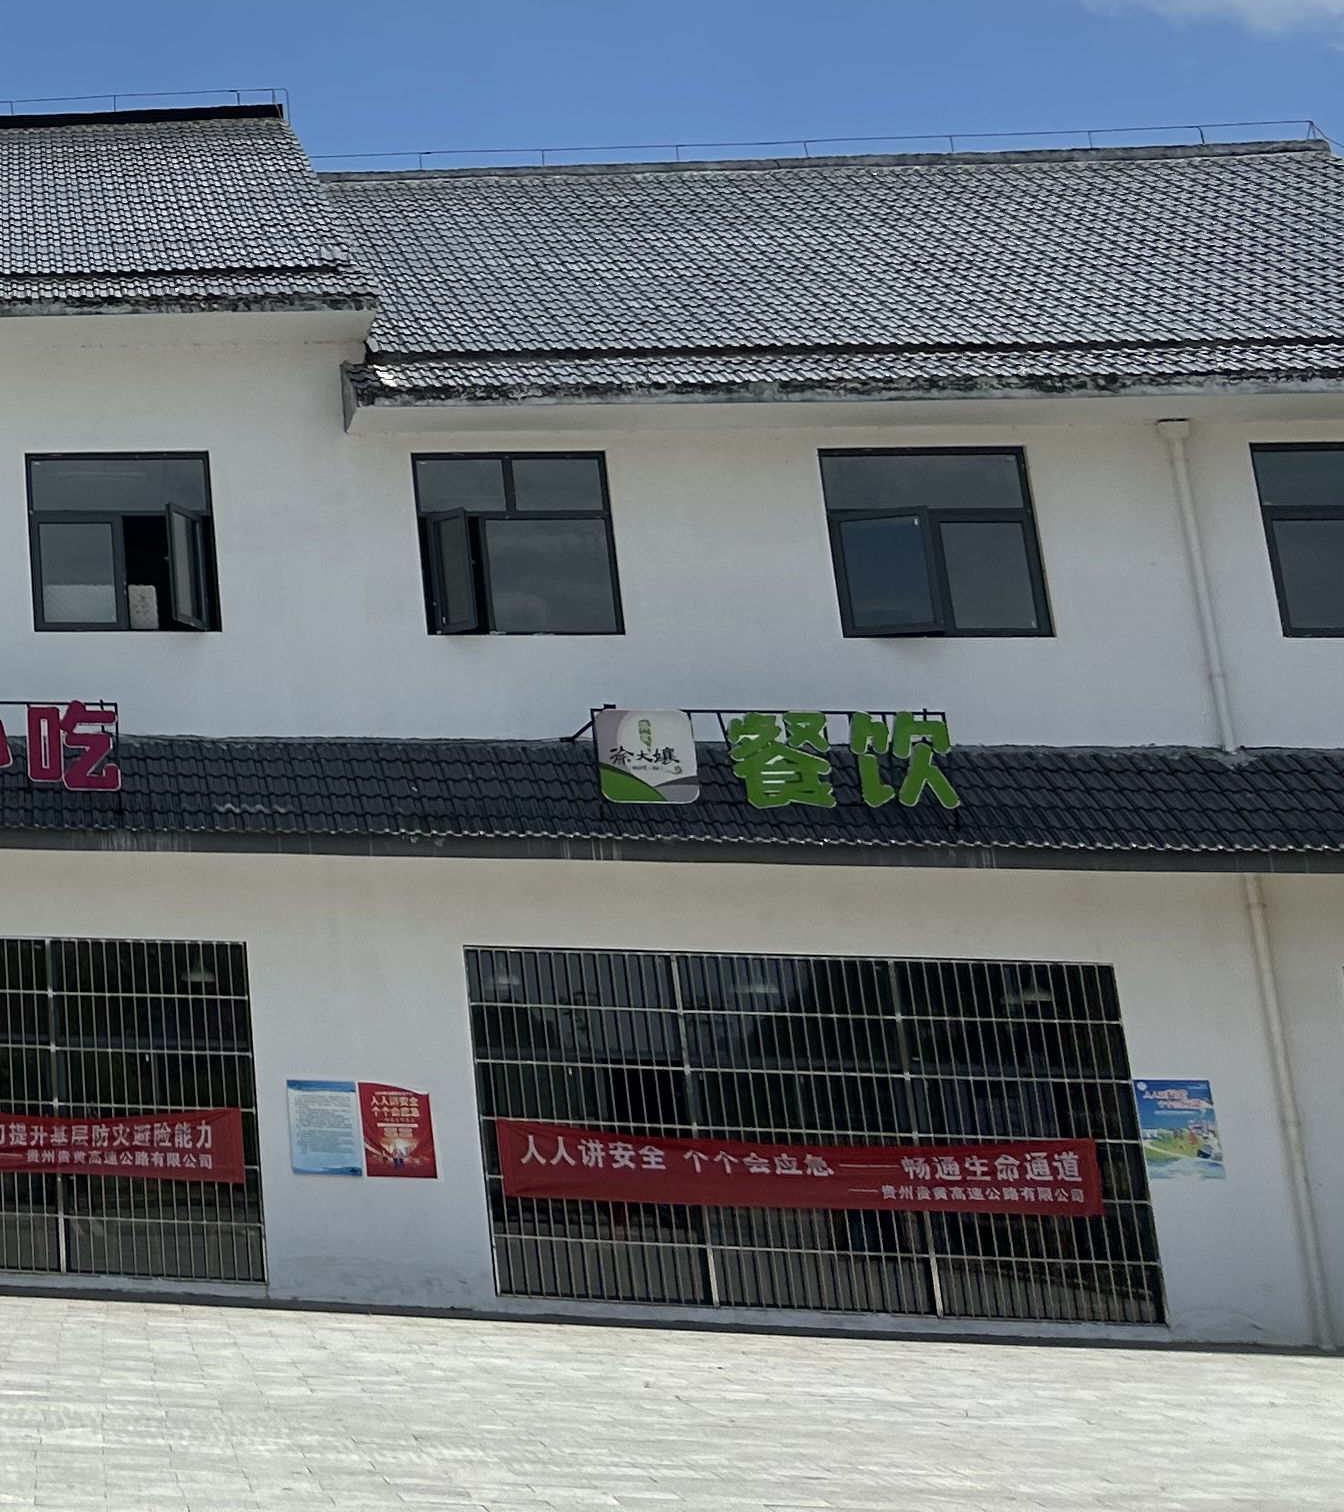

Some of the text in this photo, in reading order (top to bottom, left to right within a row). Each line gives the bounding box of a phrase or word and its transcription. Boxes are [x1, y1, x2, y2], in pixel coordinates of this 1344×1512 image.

[728, 711, 961, 808] 餐饮
[520, 1135, 667, 1170] 人人讲安全
[682, 1149, 835, 1177] 个个会应急
